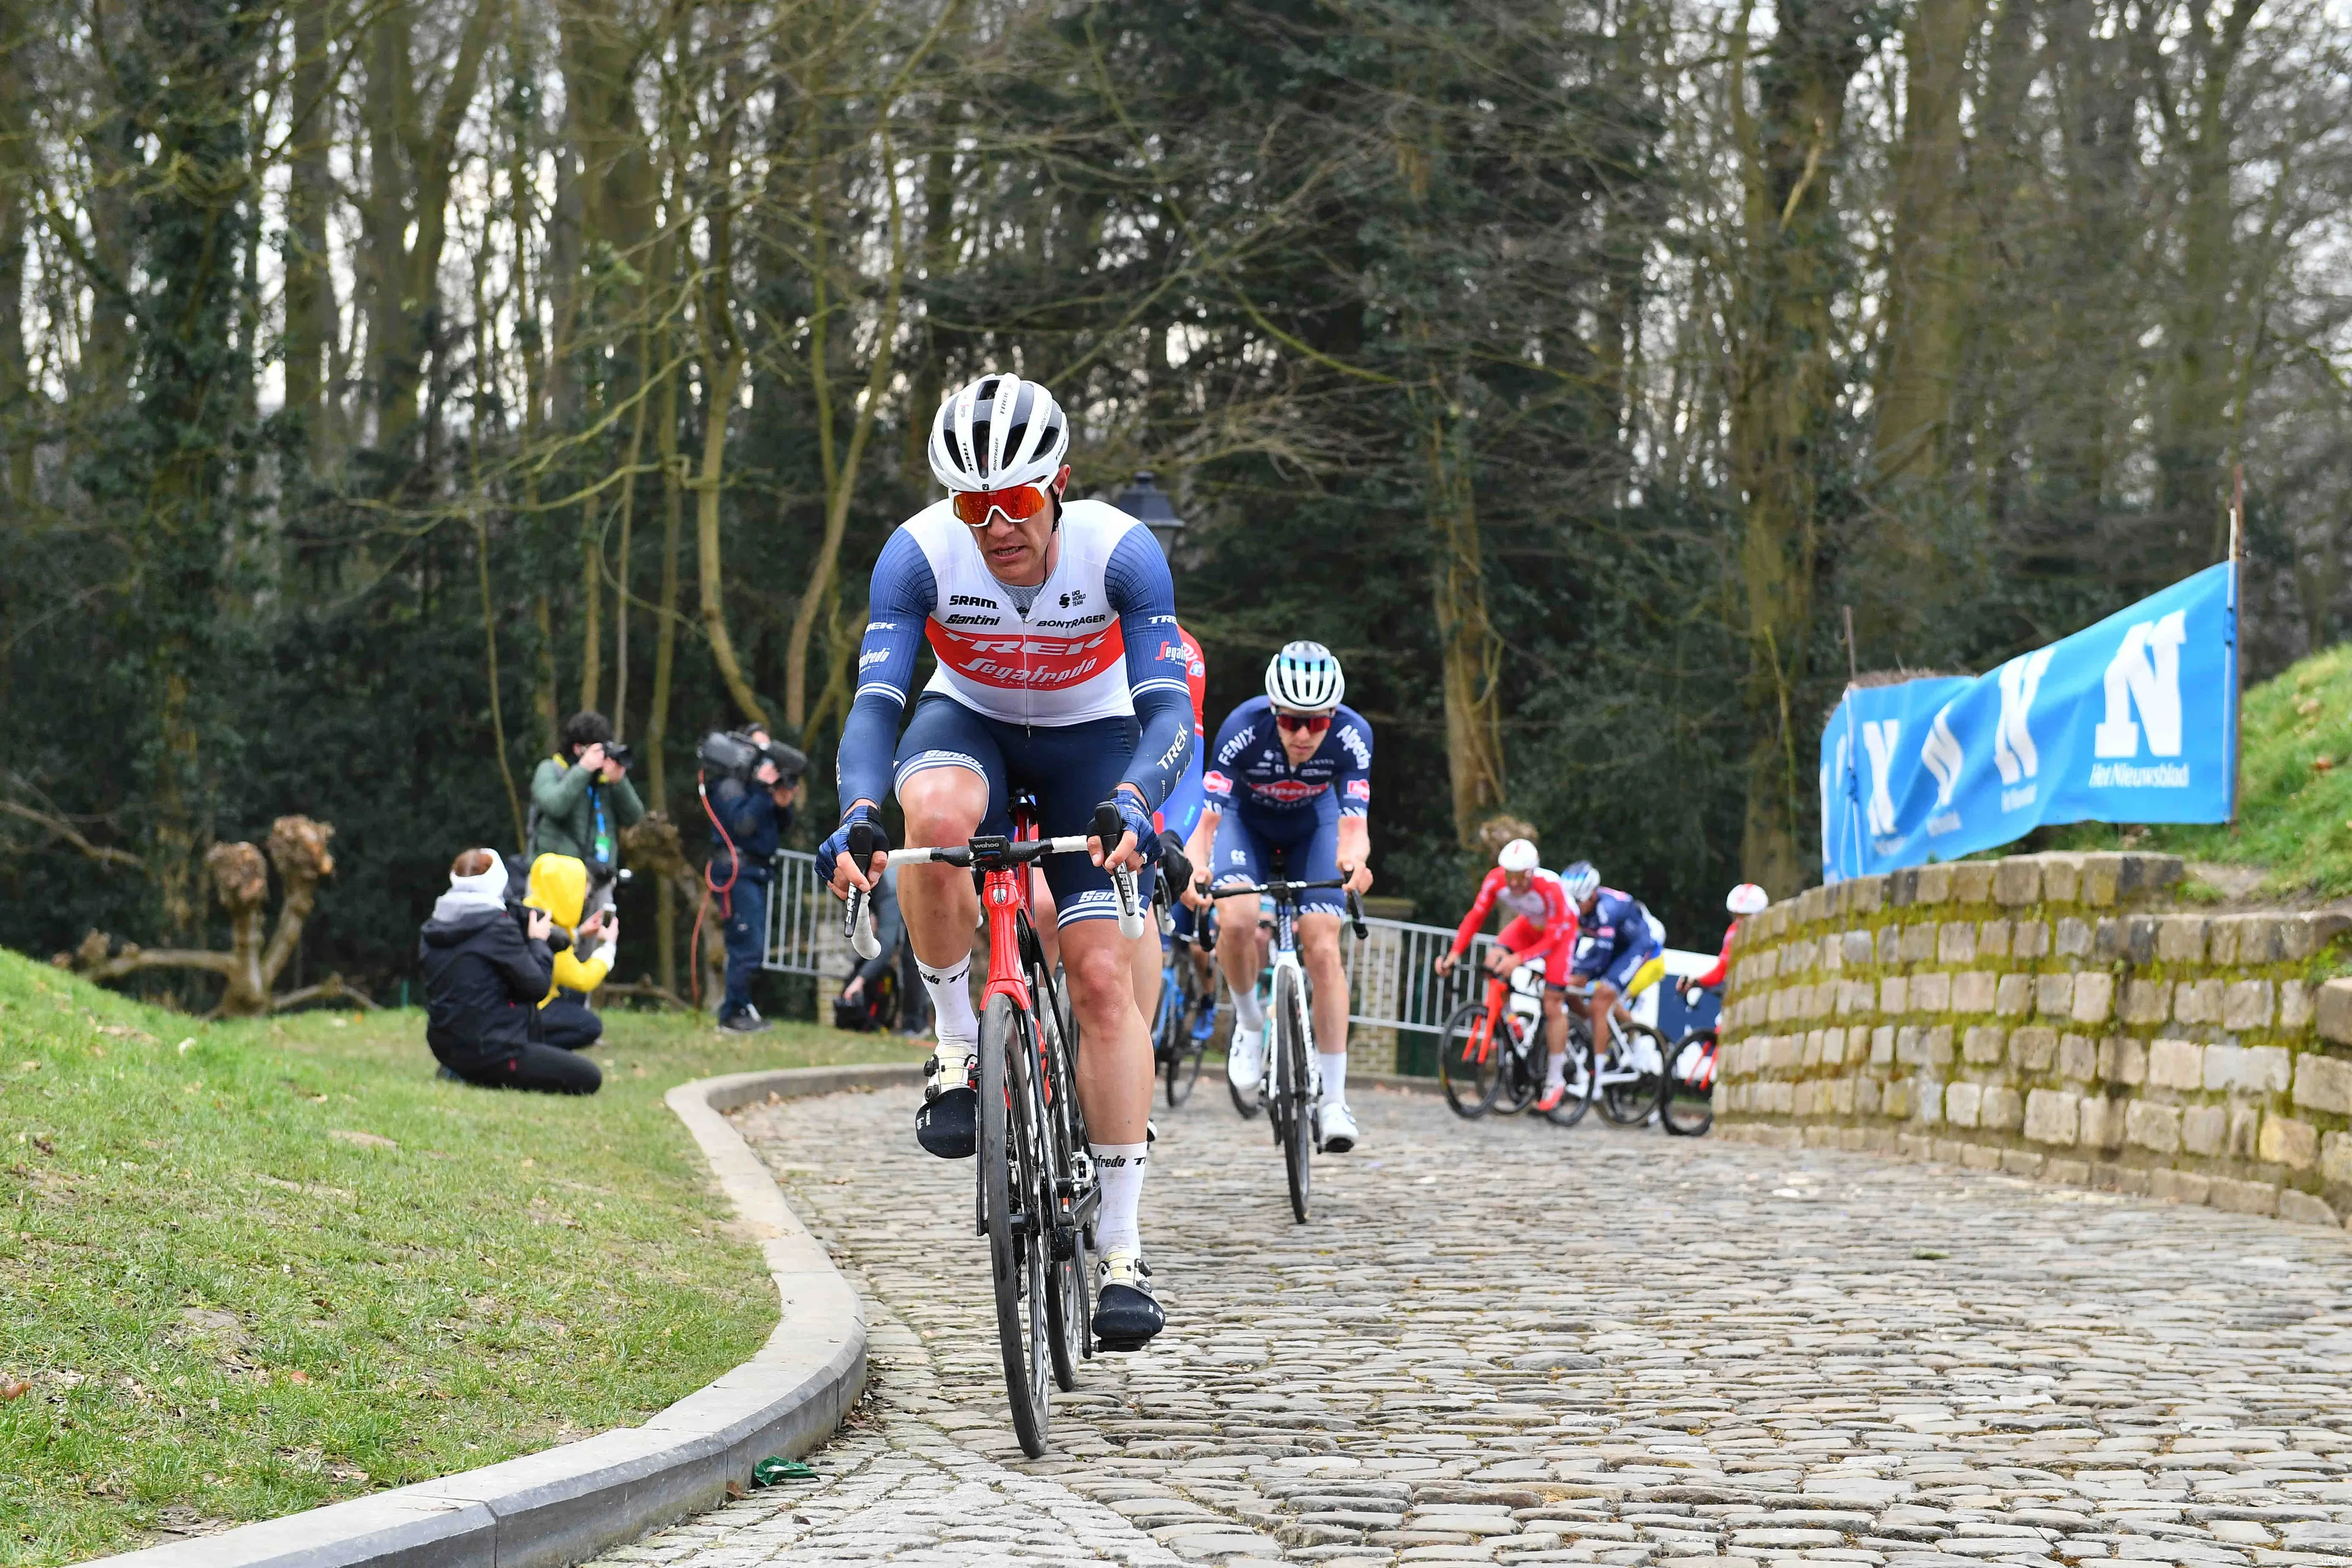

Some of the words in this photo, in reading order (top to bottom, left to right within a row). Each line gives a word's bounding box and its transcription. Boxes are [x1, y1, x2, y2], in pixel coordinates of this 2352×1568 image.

[962, 440, 975, 473] TREK
[944, 614, 1001, 626] Santini
[1036, 614, 1106, 629] BONTRAGER
[940, 625, 1109, 656] TREK
[957, 657, 1098, 684] Segafredo
[1156, 722, 1188, 771] TREK
[1218, 725, 1256, 766] FENIX
[2111, 763, 2190, 788] Nieuwsblad
